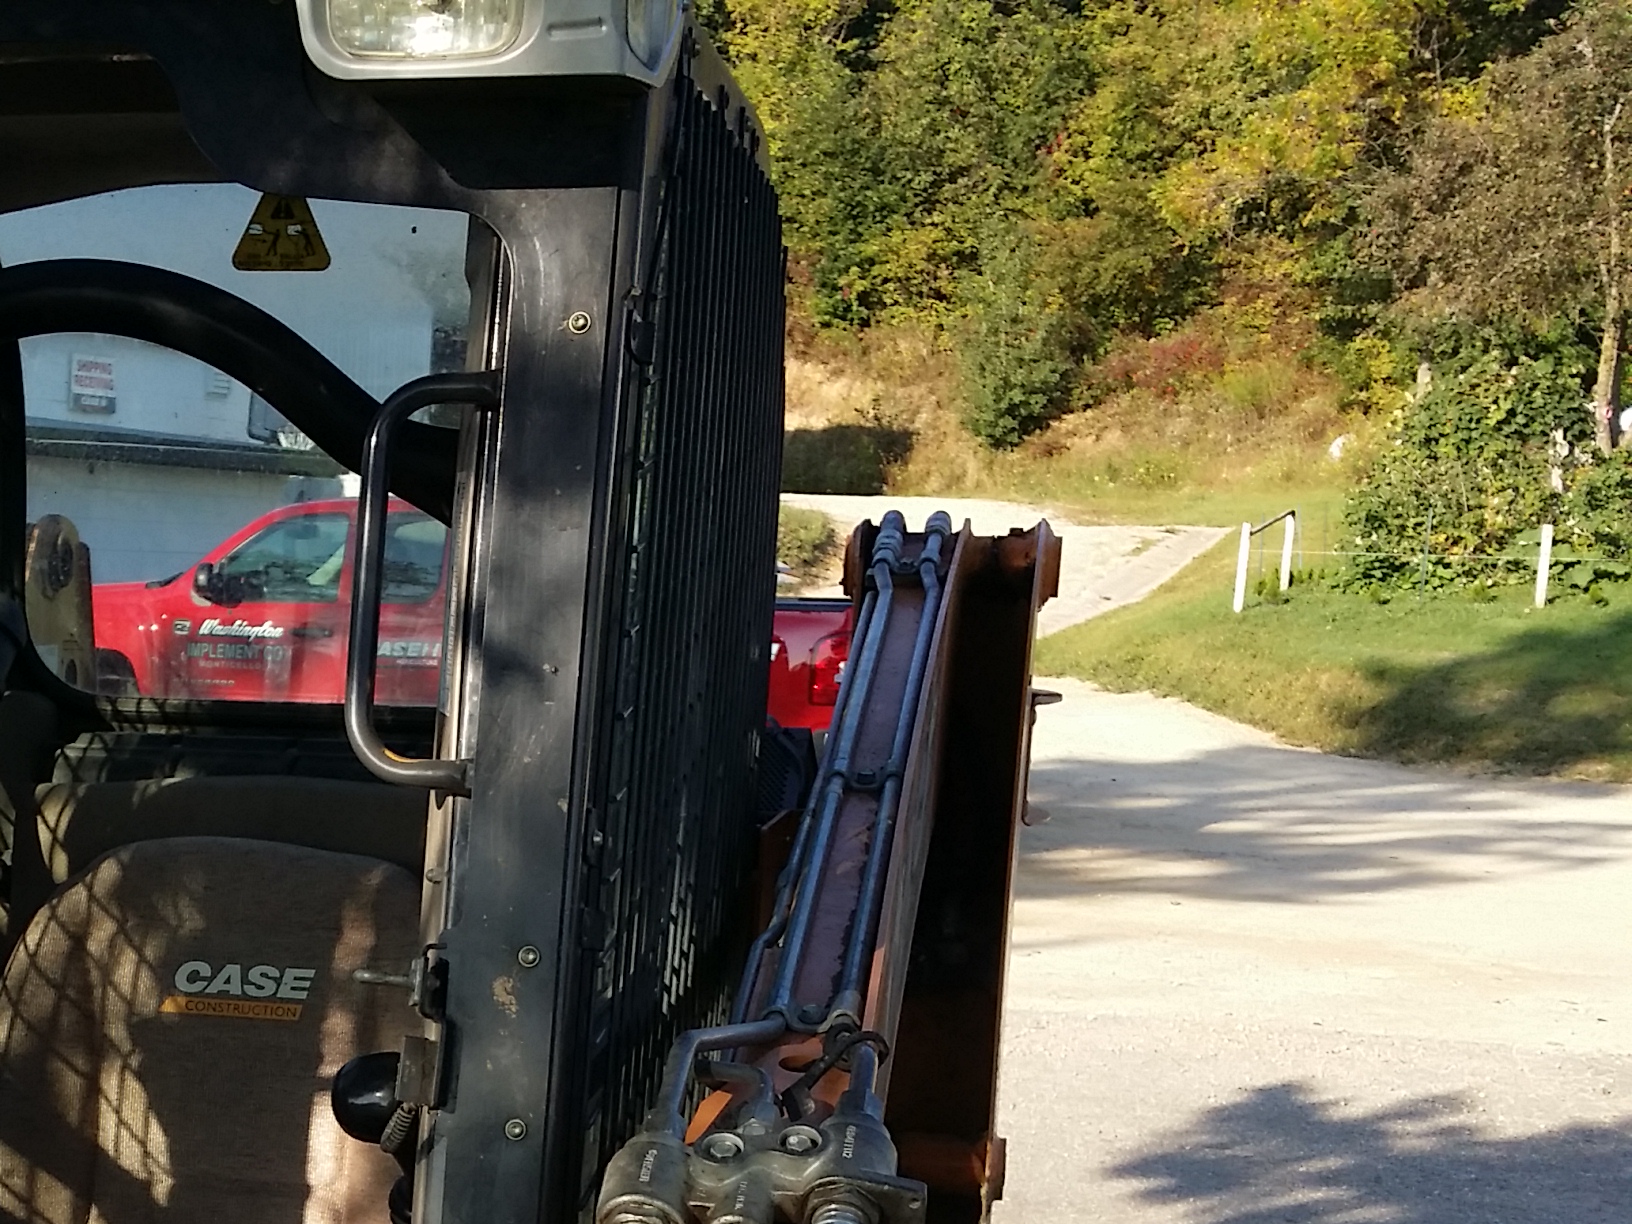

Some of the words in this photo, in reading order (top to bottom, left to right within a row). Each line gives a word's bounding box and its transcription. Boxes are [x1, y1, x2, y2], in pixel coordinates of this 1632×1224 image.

[199, 618, 284, 642] Washington
[187, 642, 261, 659] IMPLEMENT
[174, 960, 316, 1000] CASE
[185, 1000, 298, 1017] CONSTRUCTION
